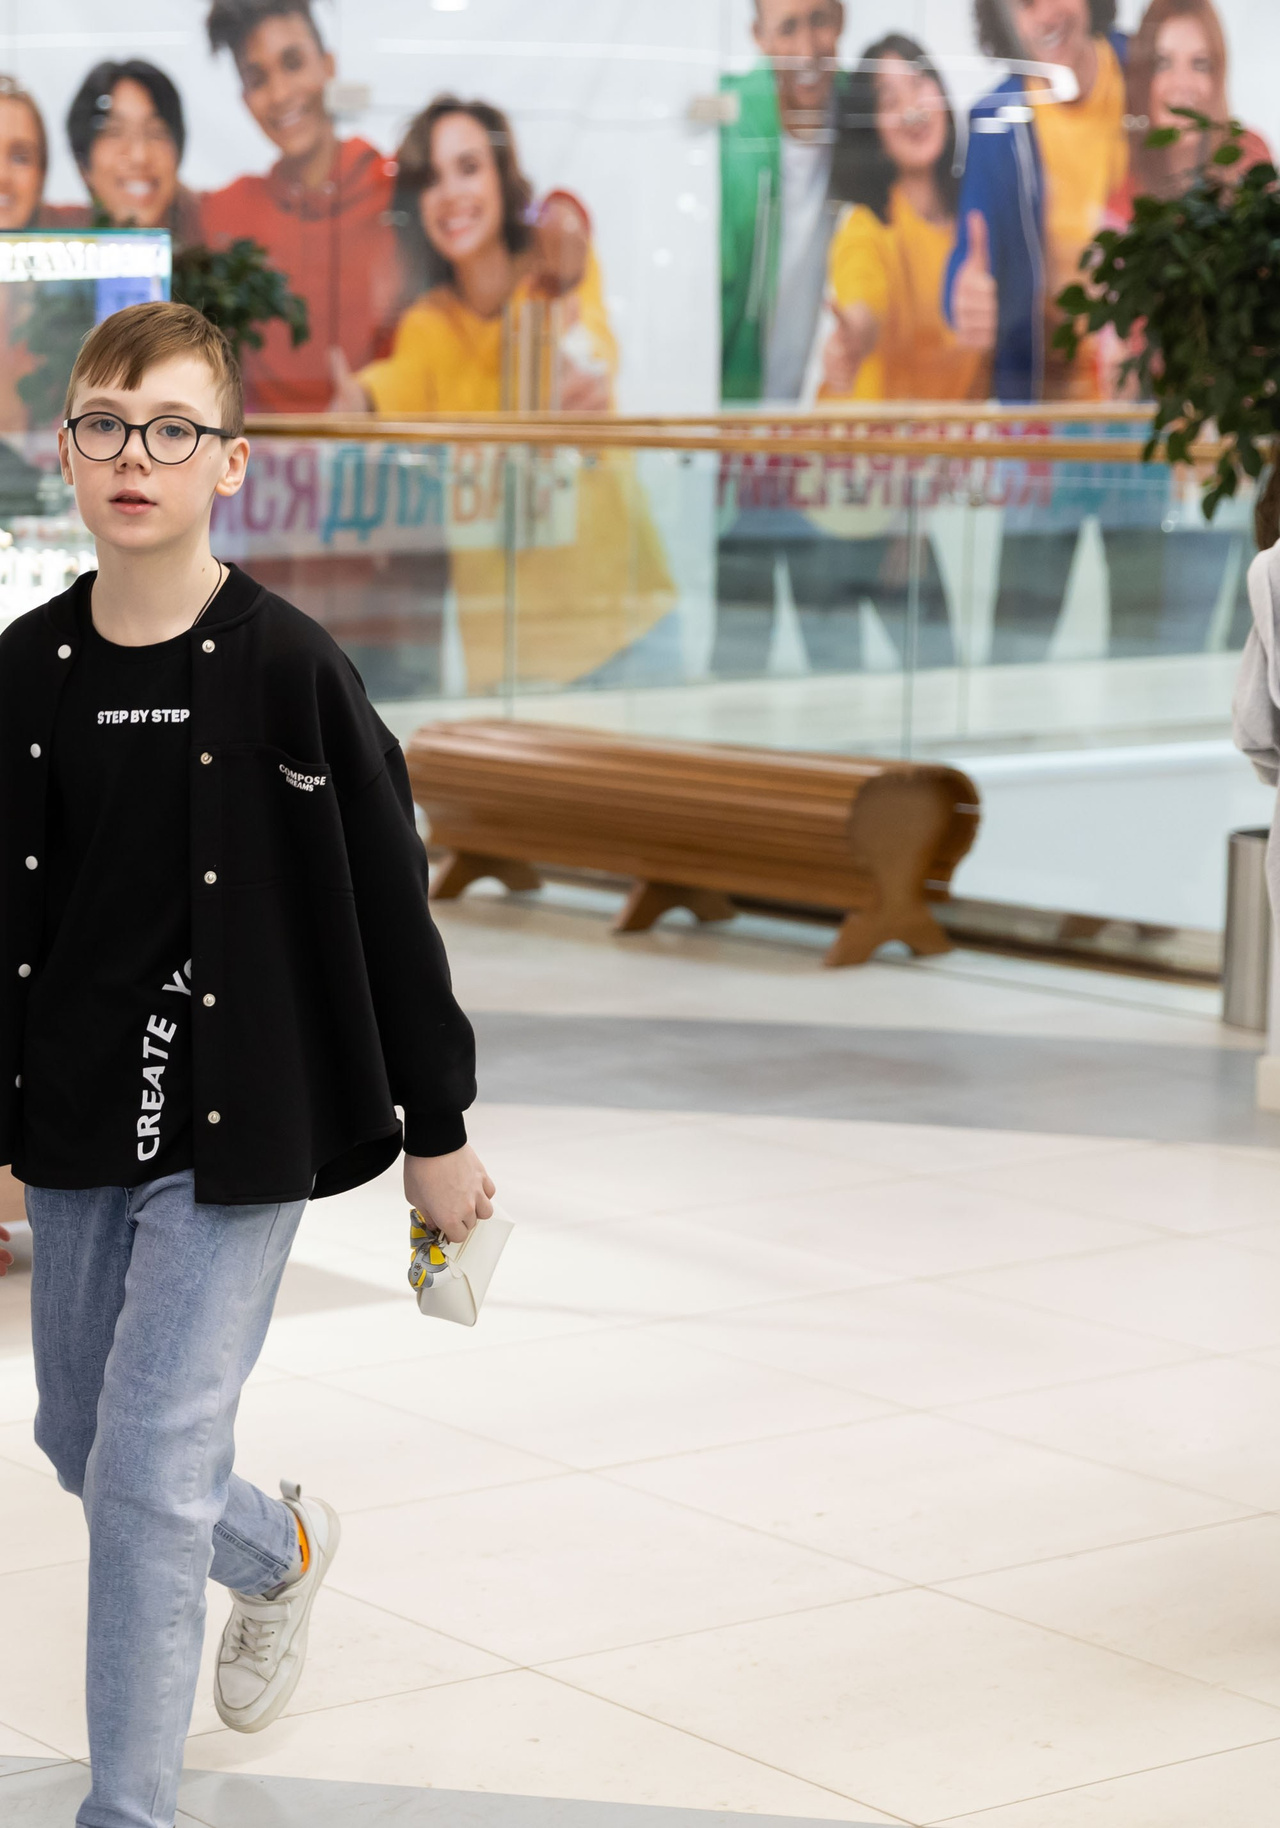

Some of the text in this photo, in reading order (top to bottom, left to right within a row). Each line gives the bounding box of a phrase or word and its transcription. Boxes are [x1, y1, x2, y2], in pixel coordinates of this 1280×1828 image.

[97, 708, 190, 725] STEP BY STEP
[279, 763, 326, 786] COMPOSE
[285, 775, 314, 792] DREAMS
[137, 1014, 178, 1161] CREATE
